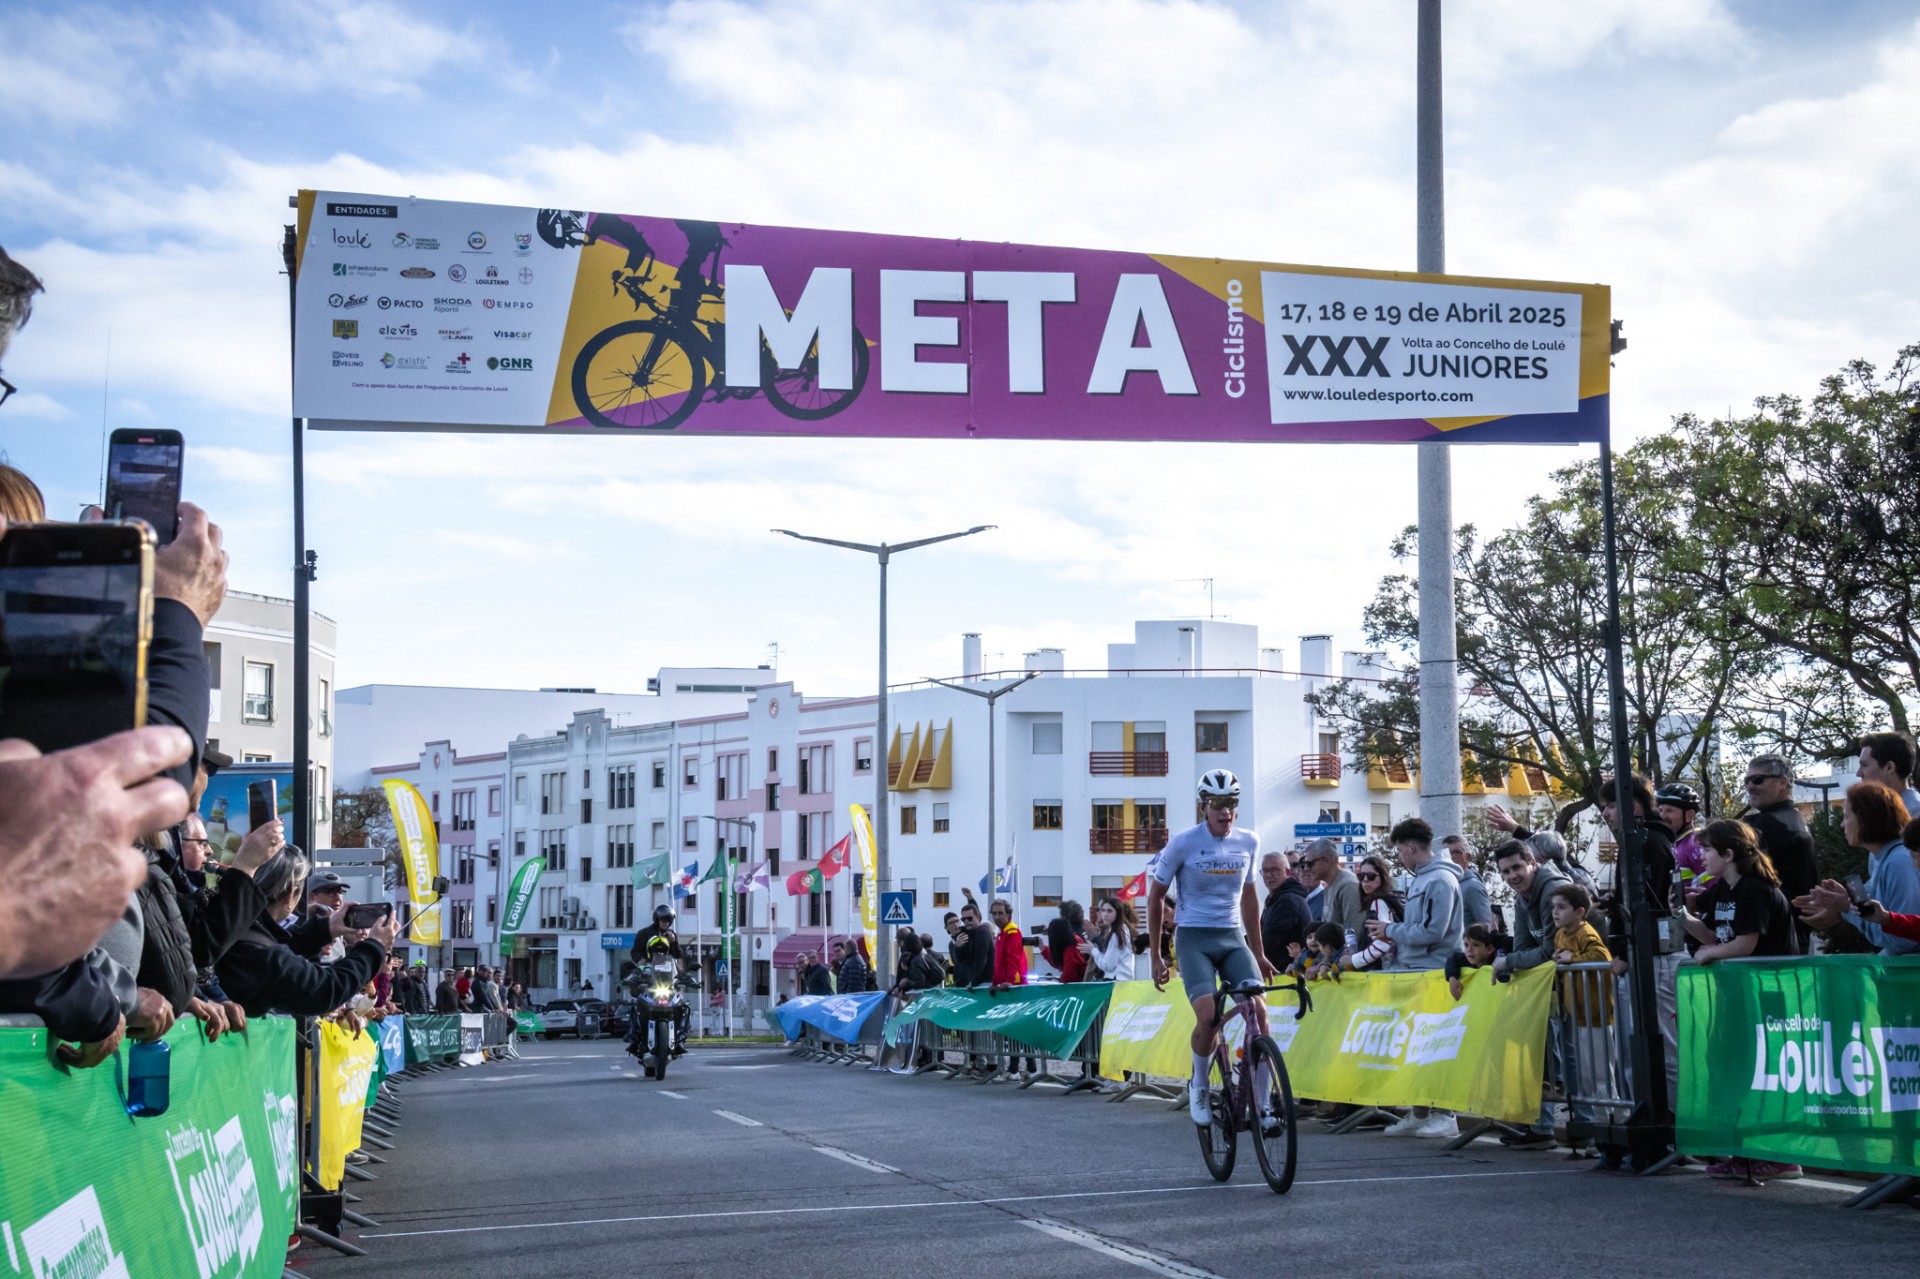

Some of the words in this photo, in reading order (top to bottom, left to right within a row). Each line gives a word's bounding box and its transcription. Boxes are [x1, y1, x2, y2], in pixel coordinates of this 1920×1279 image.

[335, 206, 390, 216] ENTIDADES:
[333, 228, 371, 248] loulé
[394, 300, 423, 309] PACTO
[1281, 303, 1312, 323] 17,
[1319, 303, 1345, 321] 18
[1353, 307, 1368, 321] e
[1375, 304, 1401, 325] 19
[1408, 302, 1440, 323] de
[1446, 302, 1503, 324] Abril
[1509, 306, 1566, 327] 2025
[724, 264, 1199, 394] META
[1224, 279, 1245, 399] Ciclismo
[1282, 334, 1391, 378] XXX
[1402, 337, 1432, 350] Volta
[1436, 340, 1450, 350] ao
[1453, 338, 1511, 351] Concelho
[1513, 338, 1529, 351] de
[1532, 338, 1566, 352] Loulé
[500, 358, 533, 369] GNR
[1402, 354, 1548, 379] JUNIORES
[1284, 388, 1474, 404] www.louledesporto.com
[507, 894, 527, 928] Loulé
[1340, 1006, 1415, 1058] Loulé
[1766, 1013, 1810, 1032] Concelho
[1811, 1013, 1820, 1031] de
[1751, 1020, 1875, 1097] Loulé
[165, 1128, 238, 1279] Loulé
